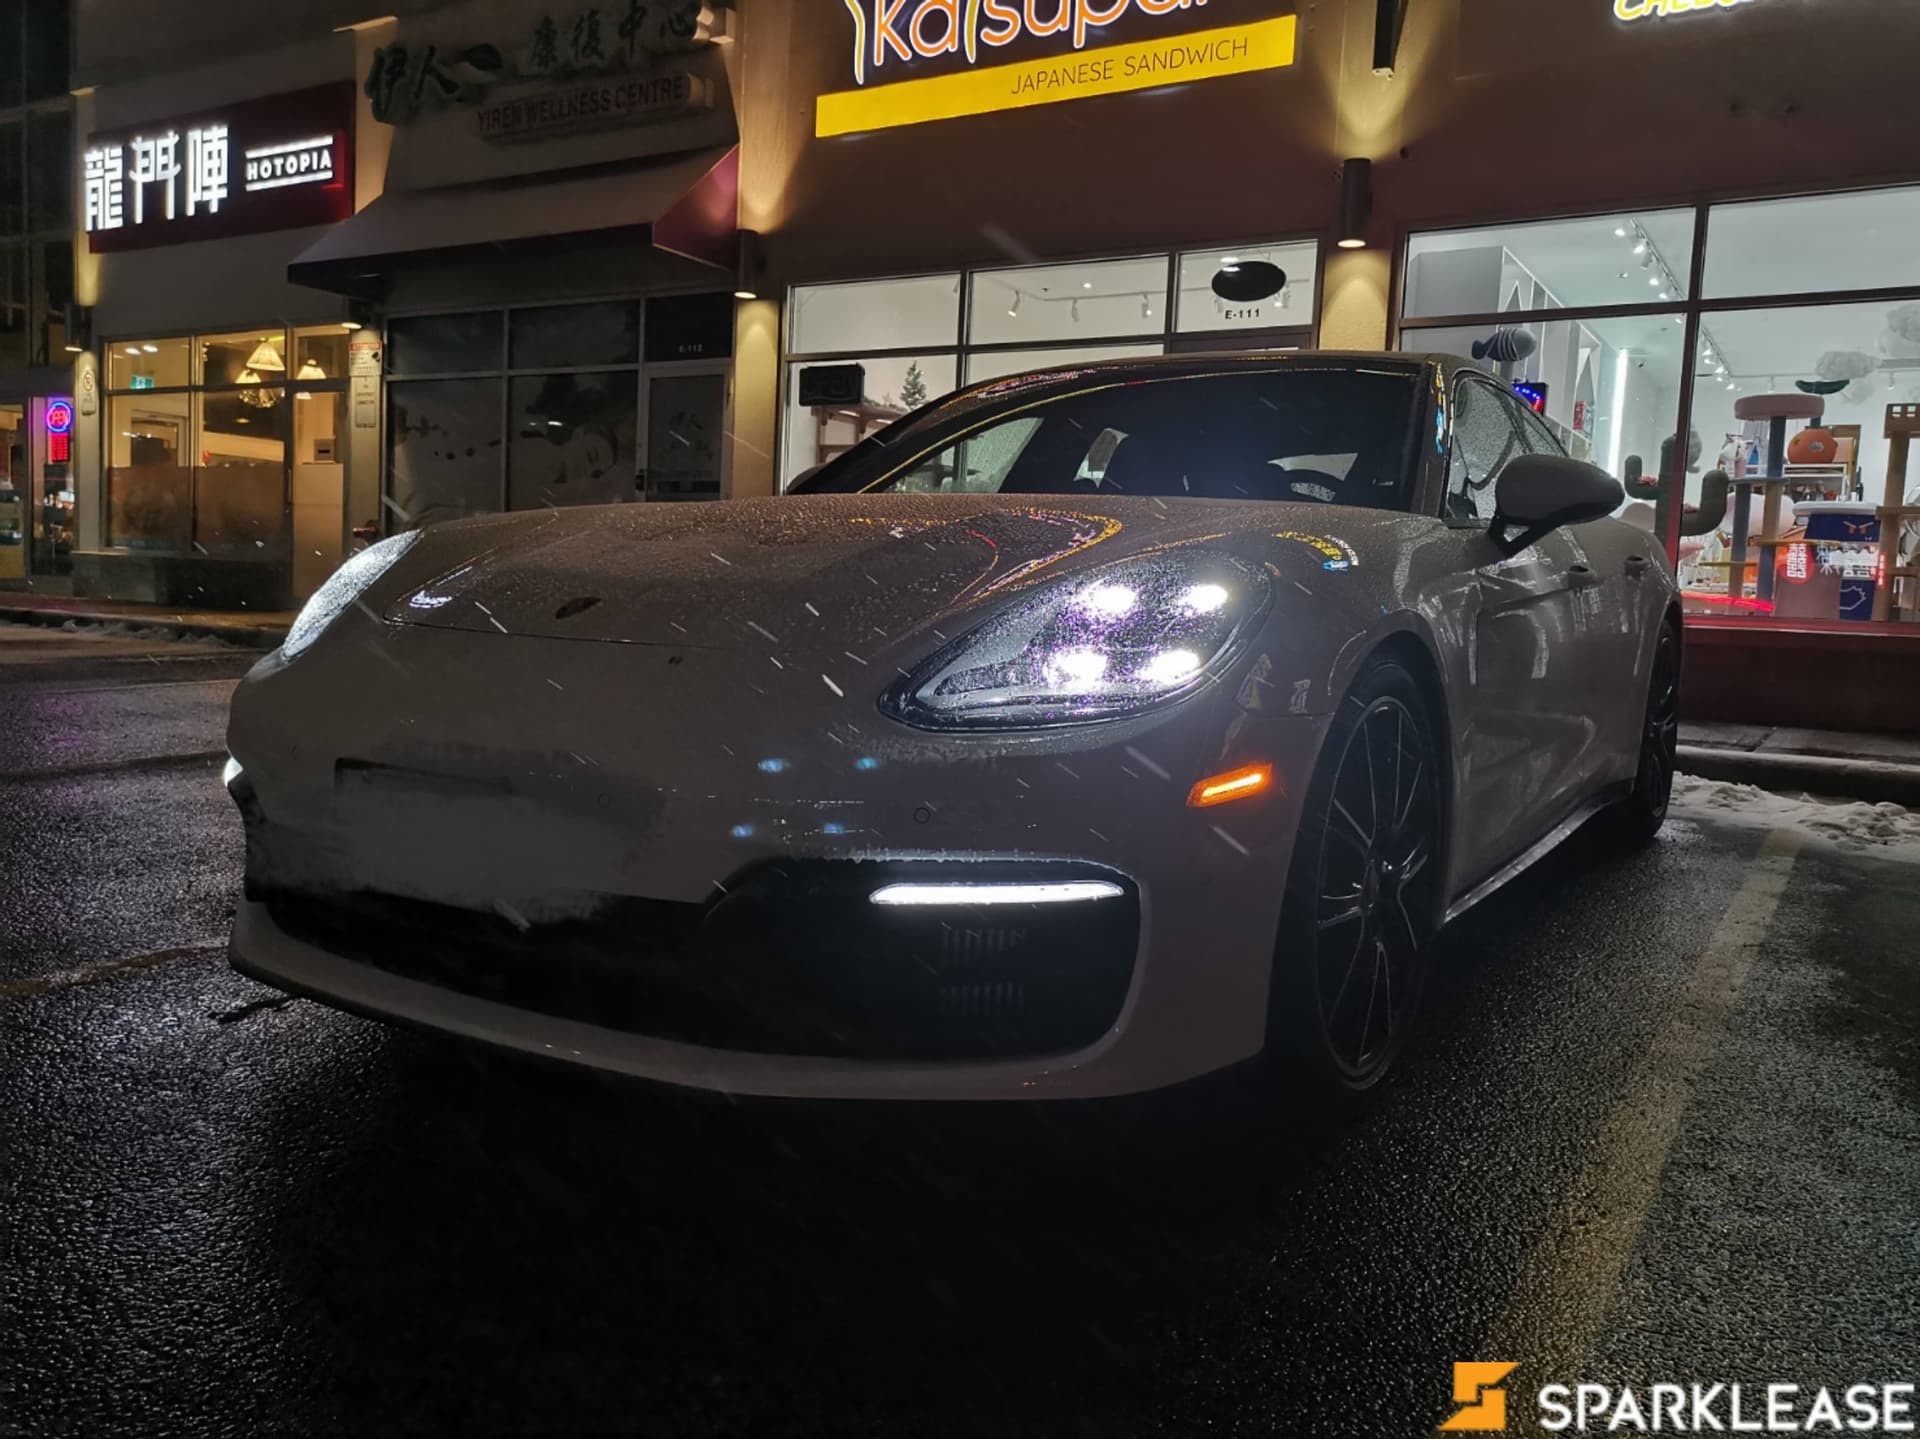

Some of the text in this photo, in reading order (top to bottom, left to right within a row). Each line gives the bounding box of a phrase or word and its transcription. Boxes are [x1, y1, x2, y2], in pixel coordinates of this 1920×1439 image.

[1011, 37, 1247, 95] JAPANESE SANDWICH
[478, 75, 684, 132] YIREN WELLNESS CENTRE
[246, 149, 332, 181] HOTOPIA
[1225, 308, 1260, 320] E-111
